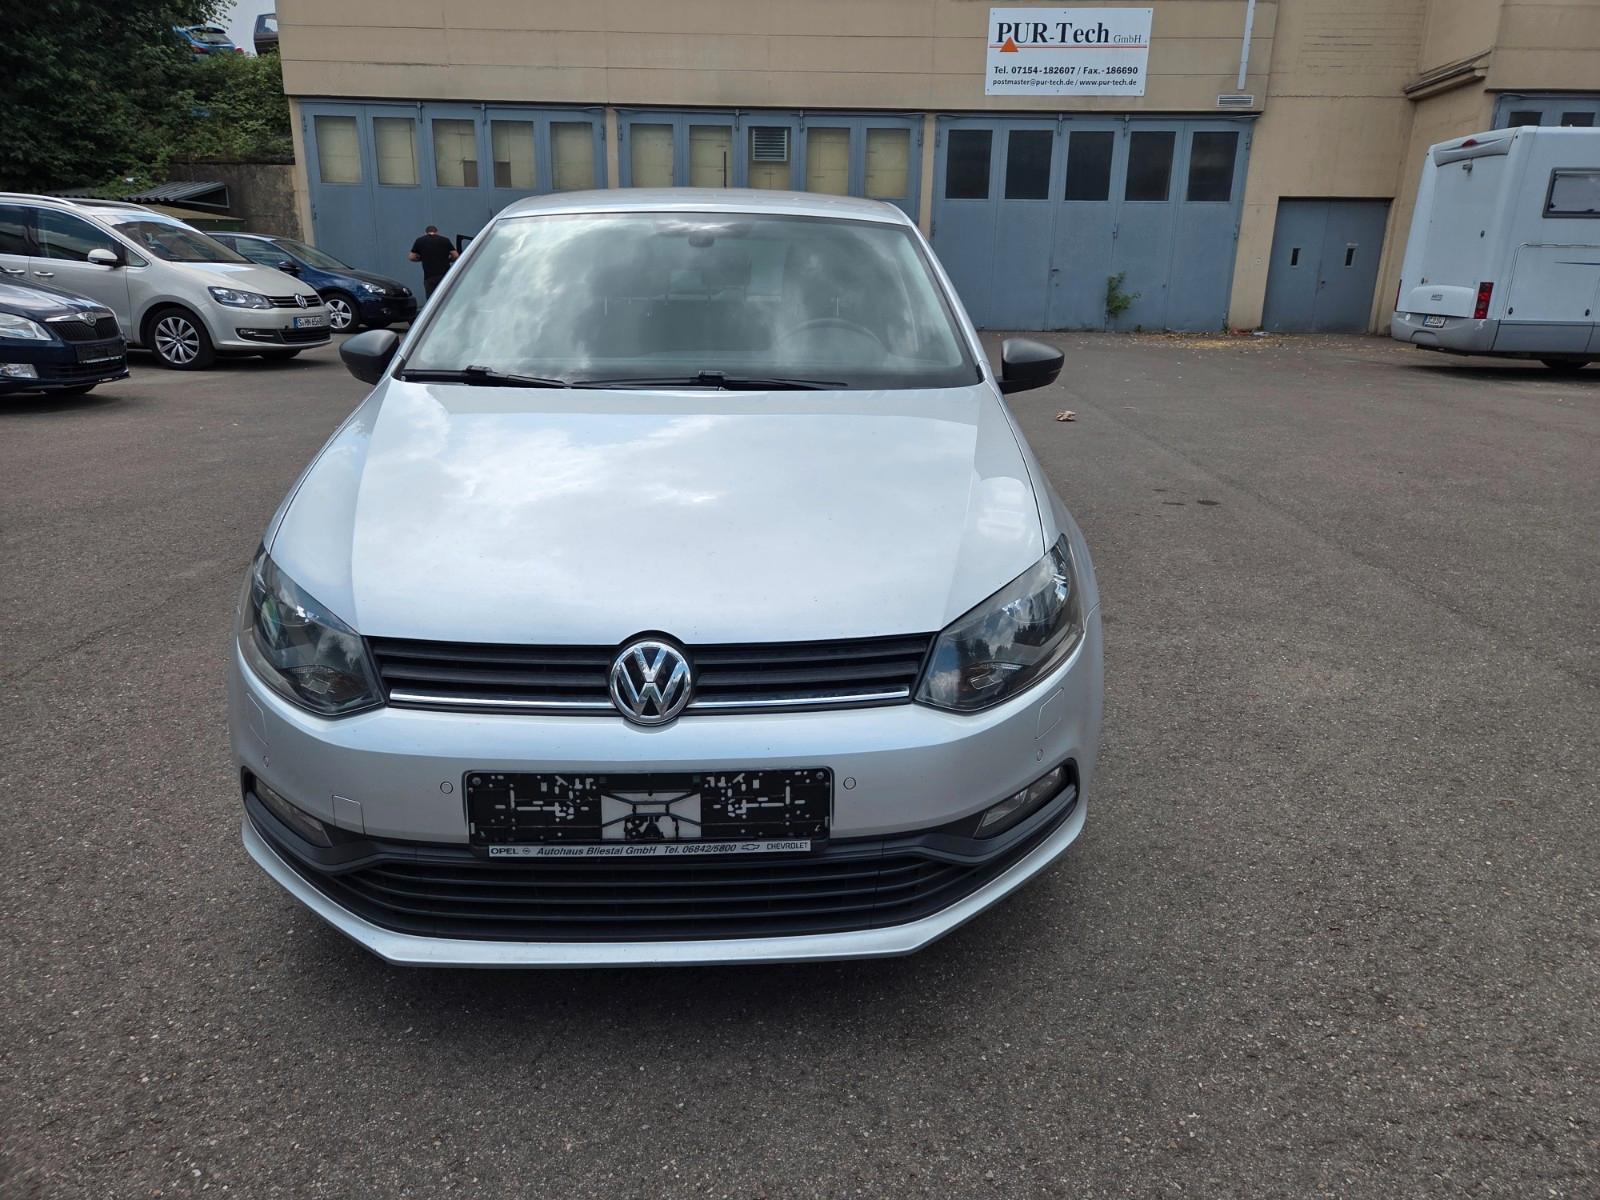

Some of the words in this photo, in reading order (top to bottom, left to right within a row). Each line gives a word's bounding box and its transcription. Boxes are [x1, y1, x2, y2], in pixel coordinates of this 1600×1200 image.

[997, 22, 1109, 44] PUR-Tech
[1113, 34, 1142, 44] GmbH
[994, 66, 1009, 74] Tel.
[1011, 66, 1075, 75] 07154-182607
[992, 79, 1074, 87] postmaster@pur-tech.de
[1079, 79, 1137, 87] www.pur-tech.de
[491, 847, 518, 855] OPEL
[537, 847, 583, 856] Autohaus
[626, 846, 656, 855] GmbH
[664, 845, 679, 854] Tel.
[682, 844, 736, 854] 06842/5800
[766, 841, 808, 850] CHEVROLET
